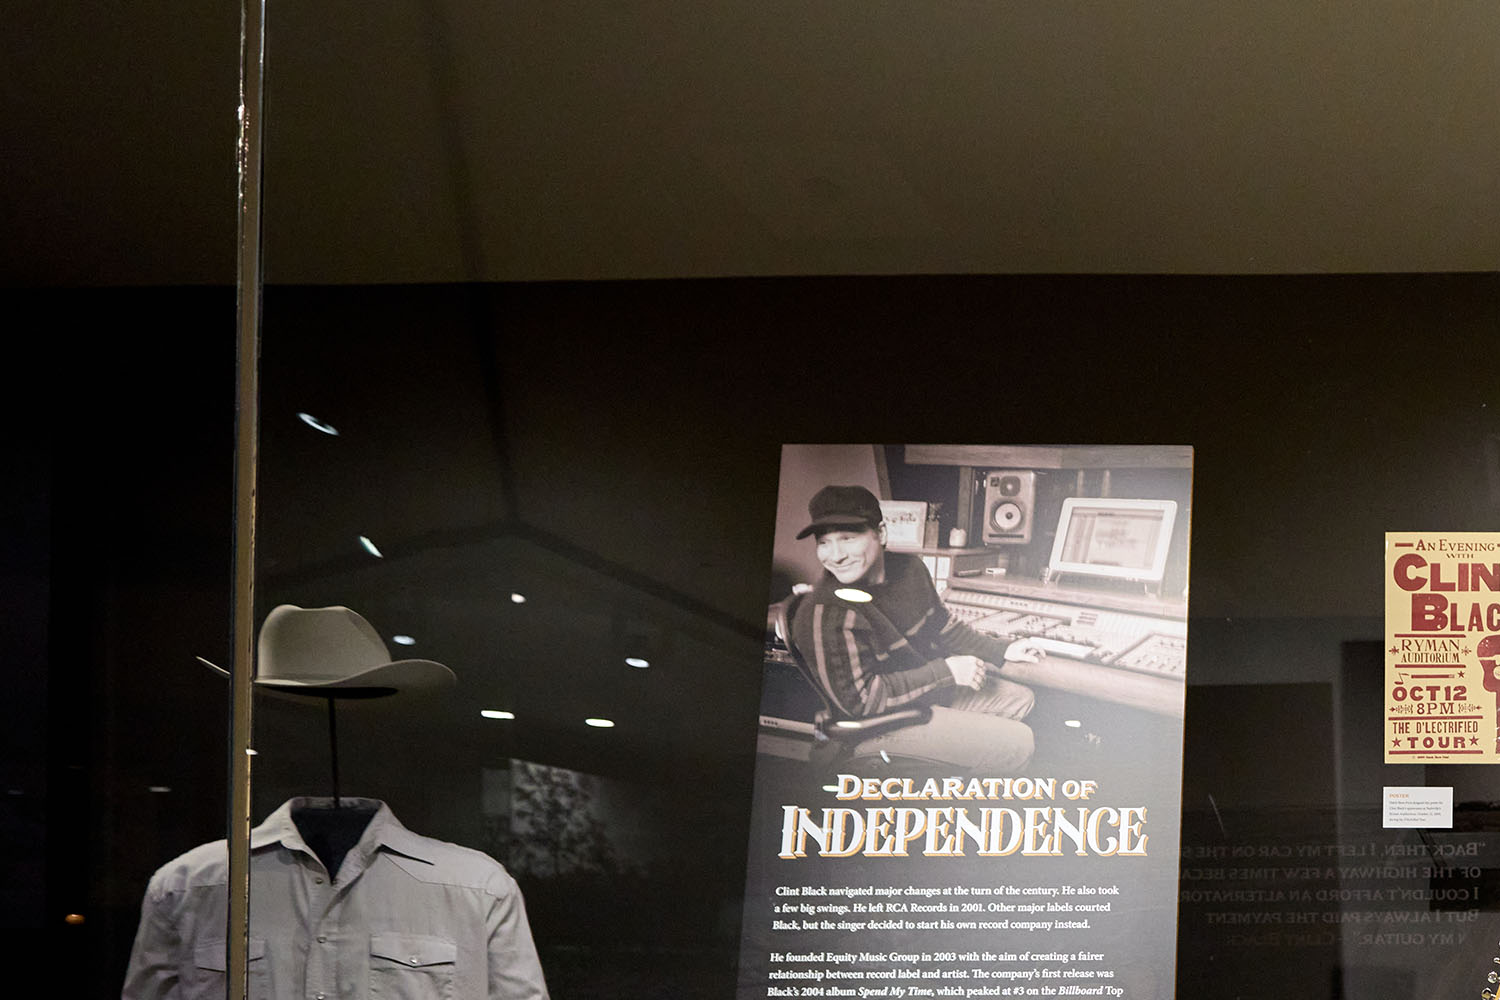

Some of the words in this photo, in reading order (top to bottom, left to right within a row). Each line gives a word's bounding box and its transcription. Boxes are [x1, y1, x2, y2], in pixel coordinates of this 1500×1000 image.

[1415, 539, 1436, 551] AN
[1439, 539, 1495, 551] EVENING
[1401, 639, 1460, 652] RYMAN
[1400, 652, 1460, 663] AUDITORIUM
[1392, 685, 1441, 702] OCT
[1444, 685, 1467, 702] 12
[1416, 702, 1454, 715] 8PM
[1393, 722, 1410, 734] THE
[1416, 721, 1478, 734] D'LECTRIFIED
[1407, 736, 1466, 749] TOUR
[855, 774, 1076, 801] DECLARATION
[1081, 779, 1118, 800] OF
[797, 803, 1169, 860] INDEPENDENCE
[775, 886, 799, 896] Clint
[801, 886, 827, 895] Black
[828, 885, 873, 898] navigated
[874, 886, 902, 897] major
[903, 886, 941, 897] changes
[953, 885, 969, 895] the
[993, 885, 1004, 894] of
[1005, 885, 1020, 894] the
[1022, 887, 1059, 896] century.
[1062, 886, 1075, 894] He
[1077, 885, 1095, 894] also
[1098, 885, 1119, 894] took
[782, 903, 798, 912] few
[800, 903, 815, 915] big
[816, 903, 850, 915] swings.
[853, 903, 867, 912] He
[868, 902, 883, 912] left
[885, 903, 908, 912] RCA
[910, 902, 947, 912] Records
[949, 903, 958, 911] in
[961, 903, 985, 911] 2001.
[988, 902, 1015, 911] Other
[1017, 903, 1045, 914] major
[1047, 902, 1072, 911] labels
[1075, 902, 1110, 911] courted
[772, 920, 801, 930] Black,
[802, 920, 818, 929] but
[820, 920, 836, 929] the
[837, 920, 866, 932] singer
[867, 919, 903, 929] decided
[905, 921, 915, 929] to
[916, 921, 938, 929] start
[940, 919, 954, 928] his
[978, 919, 1008, 928] record
[1010, 922, 1052, 931] company
[1054, 919, 1090, 928] instead.
